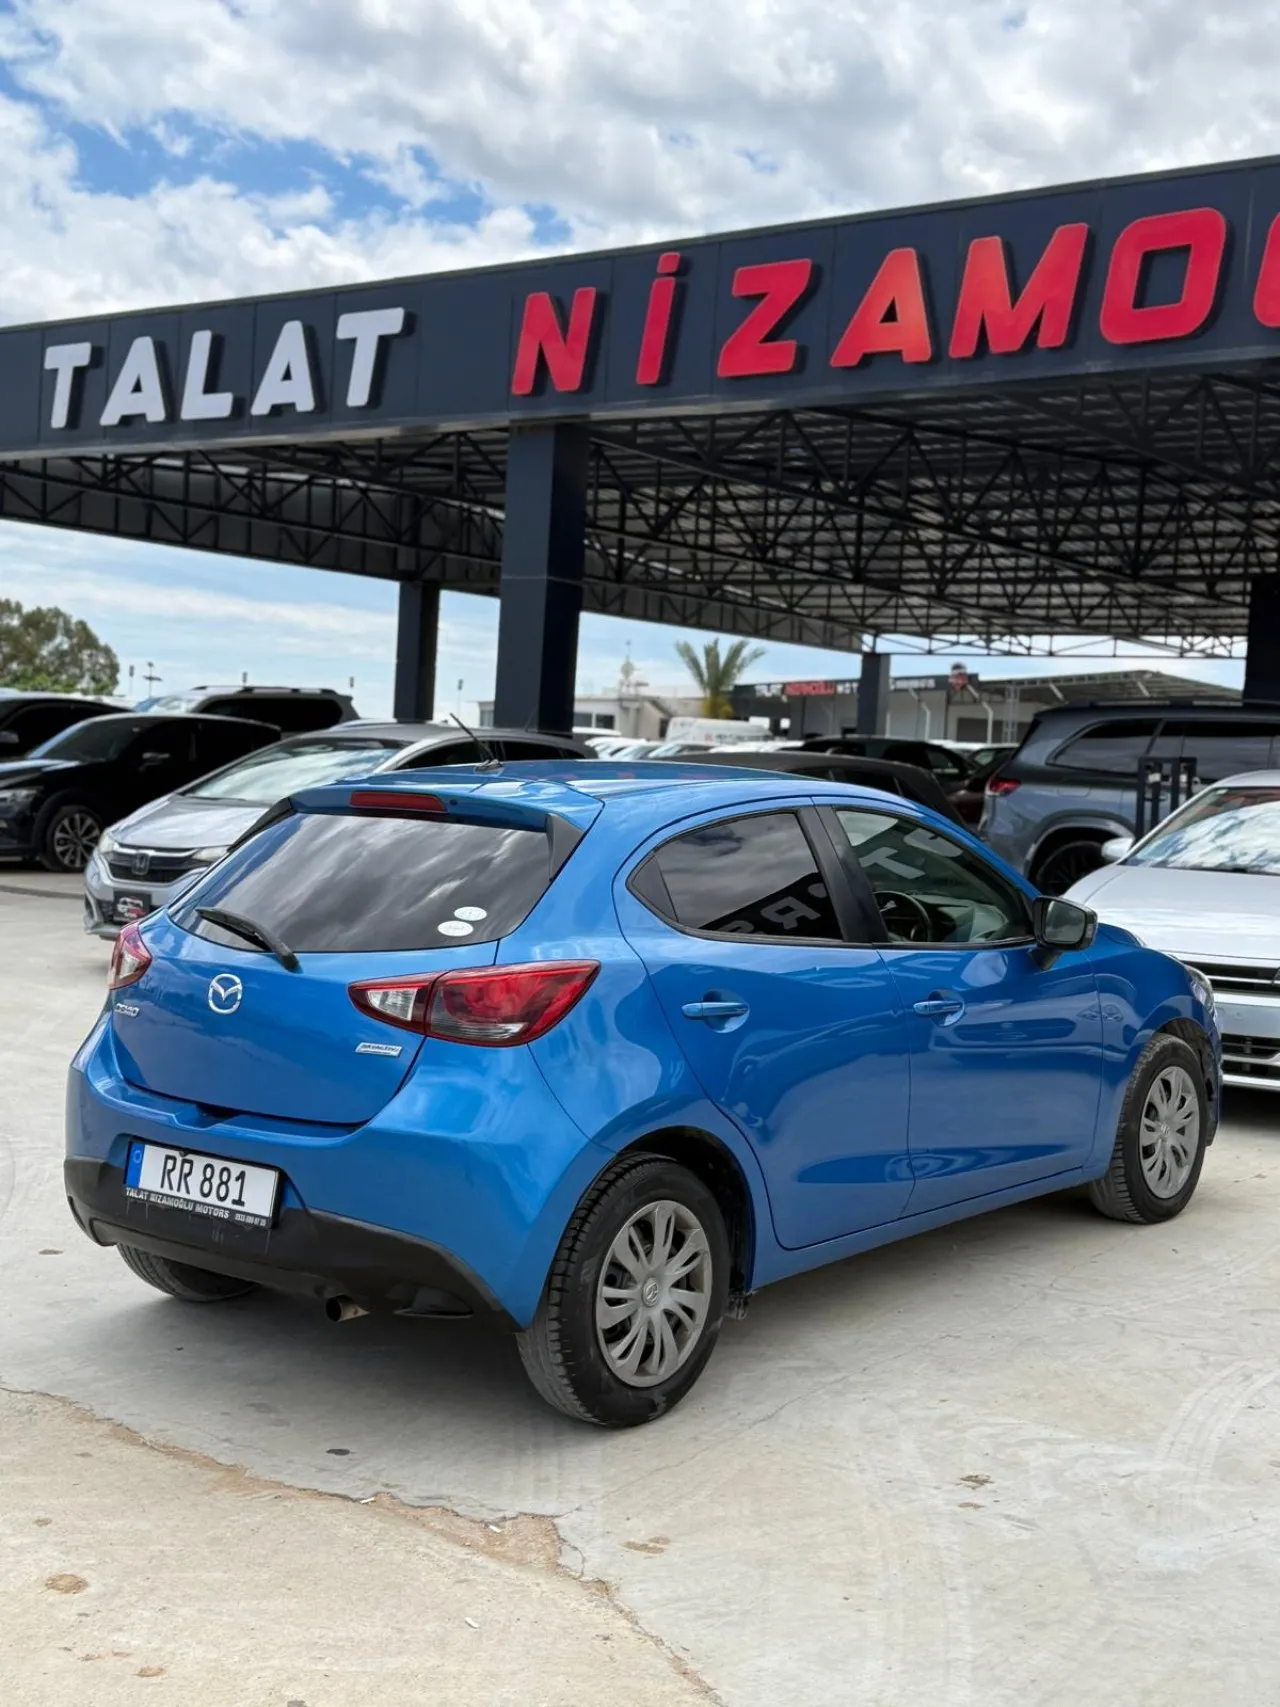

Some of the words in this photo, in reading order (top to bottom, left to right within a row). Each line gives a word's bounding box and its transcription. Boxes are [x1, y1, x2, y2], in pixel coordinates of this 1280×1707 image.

[44, 307, 405, 429] TALAT
[125, 1187, 149, 1201] TALAT
[194, 1202, 230, 1219] MOTORS
[199, 1162, 247, 1207] 881
